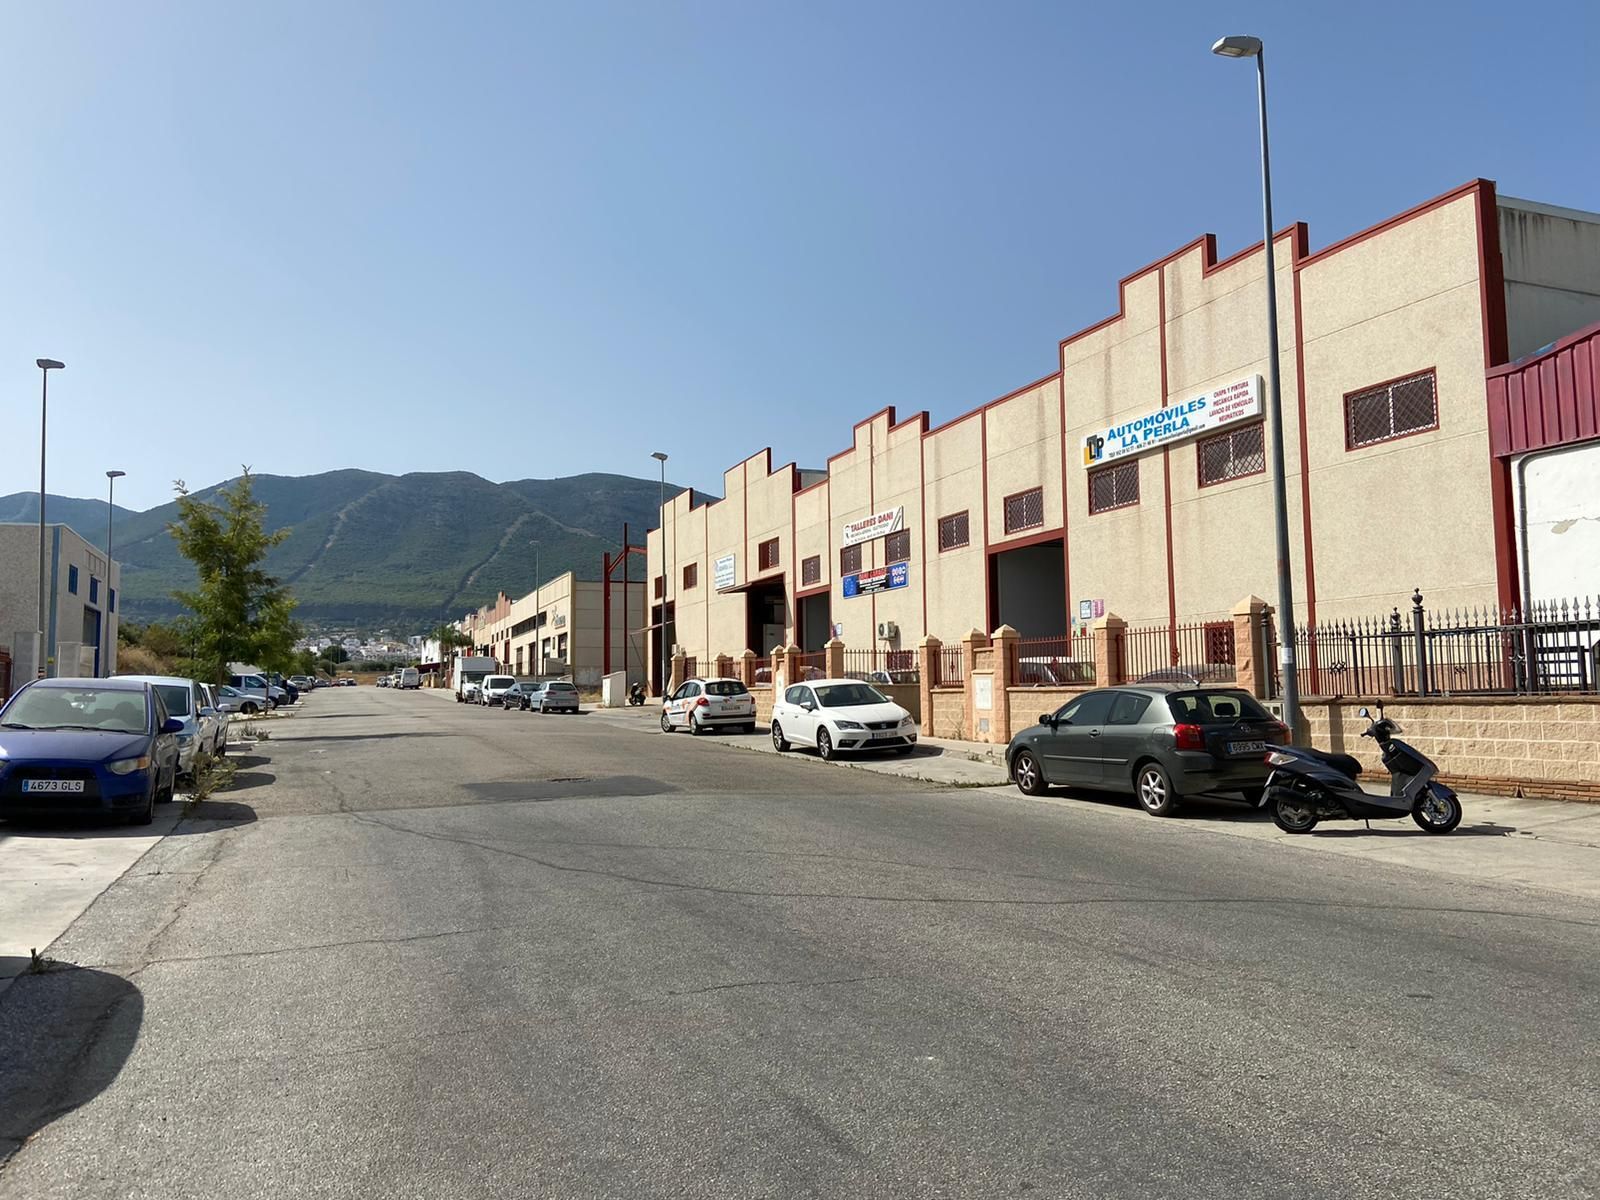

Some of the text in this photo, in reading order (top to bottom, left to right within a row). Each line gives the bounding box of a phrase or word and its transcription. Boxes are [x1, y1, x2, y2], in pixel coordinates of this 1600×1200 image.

[1107, 397, 1207, 441] AUTOMÓVILES
[1122, 434, 1139, 448] LA
[1143, 417, 1190, 440] PERLA
[851, 517, 876, 532] TALLERES
[30, 781, 81, 791] 4673 GLS
